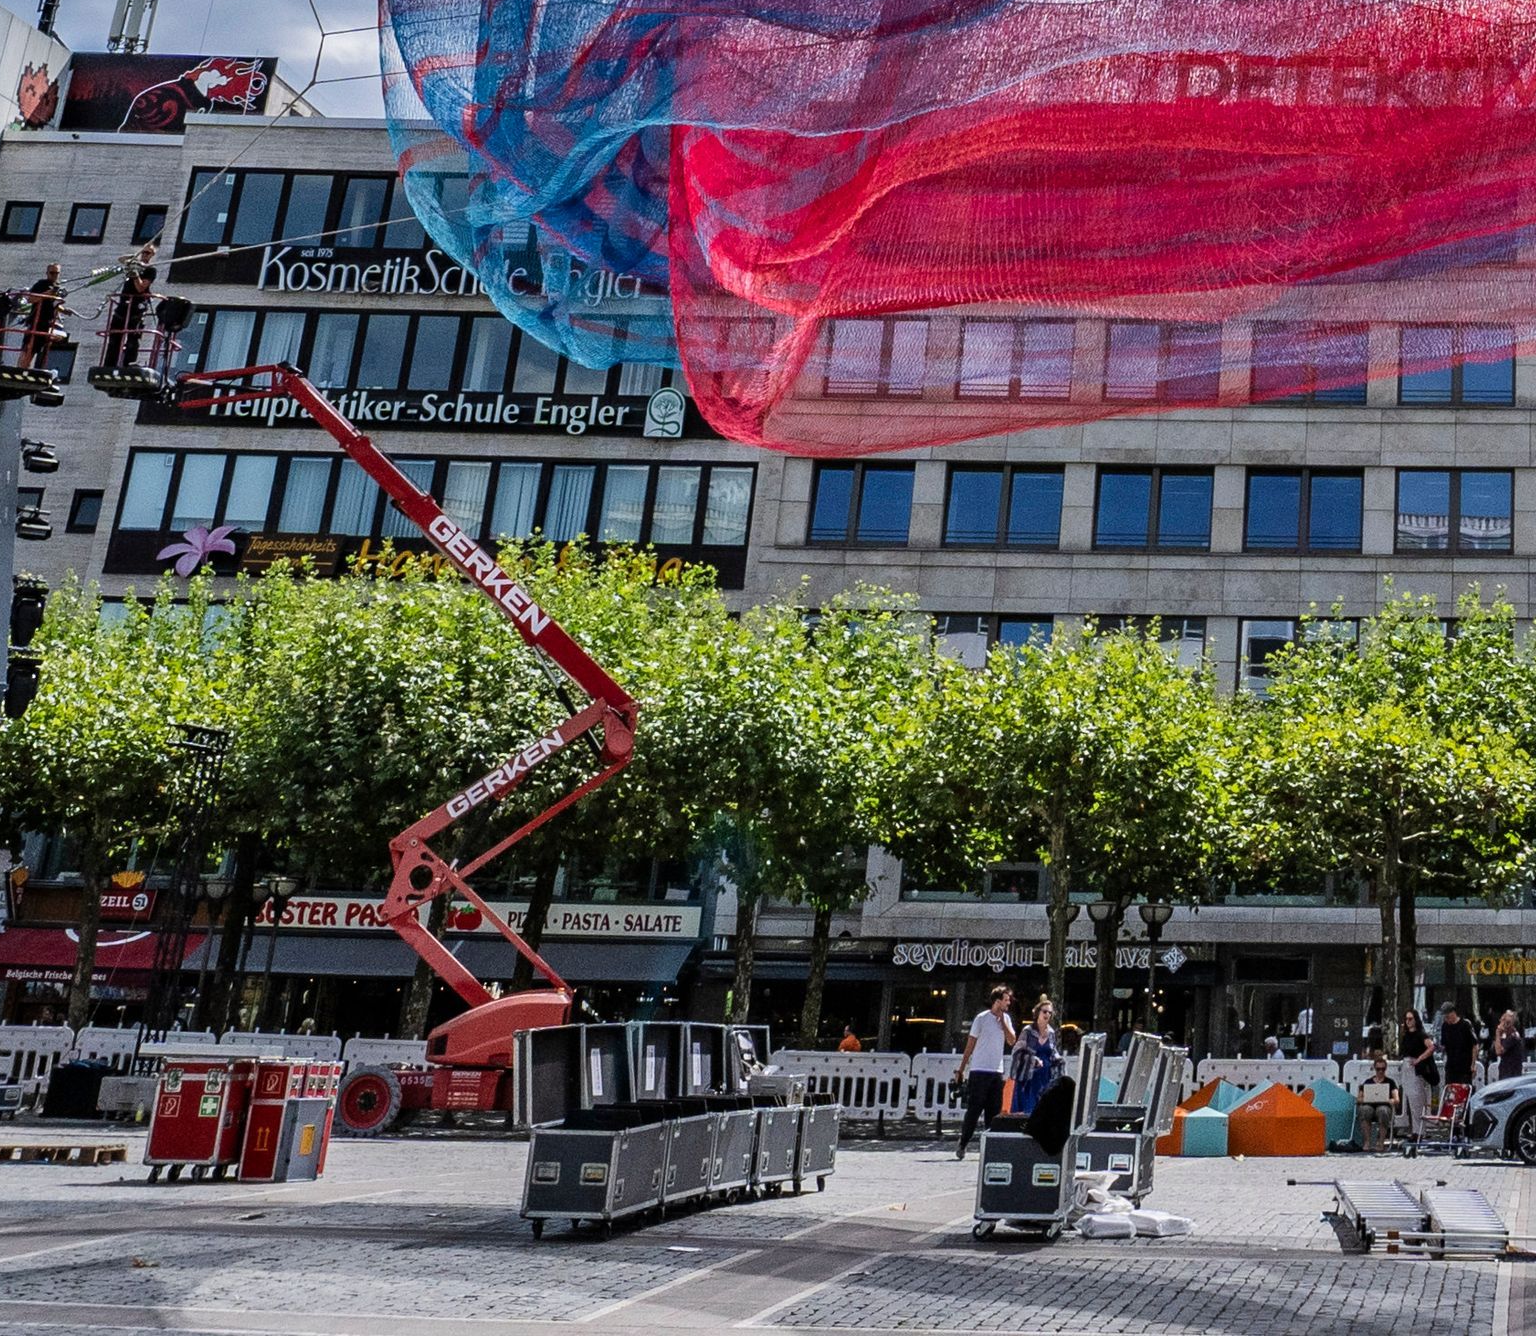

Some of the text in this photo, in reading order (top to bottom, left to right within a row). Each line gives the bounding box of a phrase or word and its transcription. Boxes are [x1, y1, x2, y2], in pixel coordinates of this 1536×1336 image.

[301, 247, 334, 258] seit 1975
[257, 246, 528, 297] KosmetikSchle
[533, 395, 630, 435] Engler
[429, 515, 551, 636] GERKEN
[446, 729, 565, 819] GERKEN
[100, 896, 130, 908] ZEIL
[561, 913, 611, 931] PASTA
[623, 914, 683, 933] SALATE
[5, 969, 43, 981] Belgische
[44, 970, 73, 980] Frische
[1333, 1018, 1349, 1029] 53
